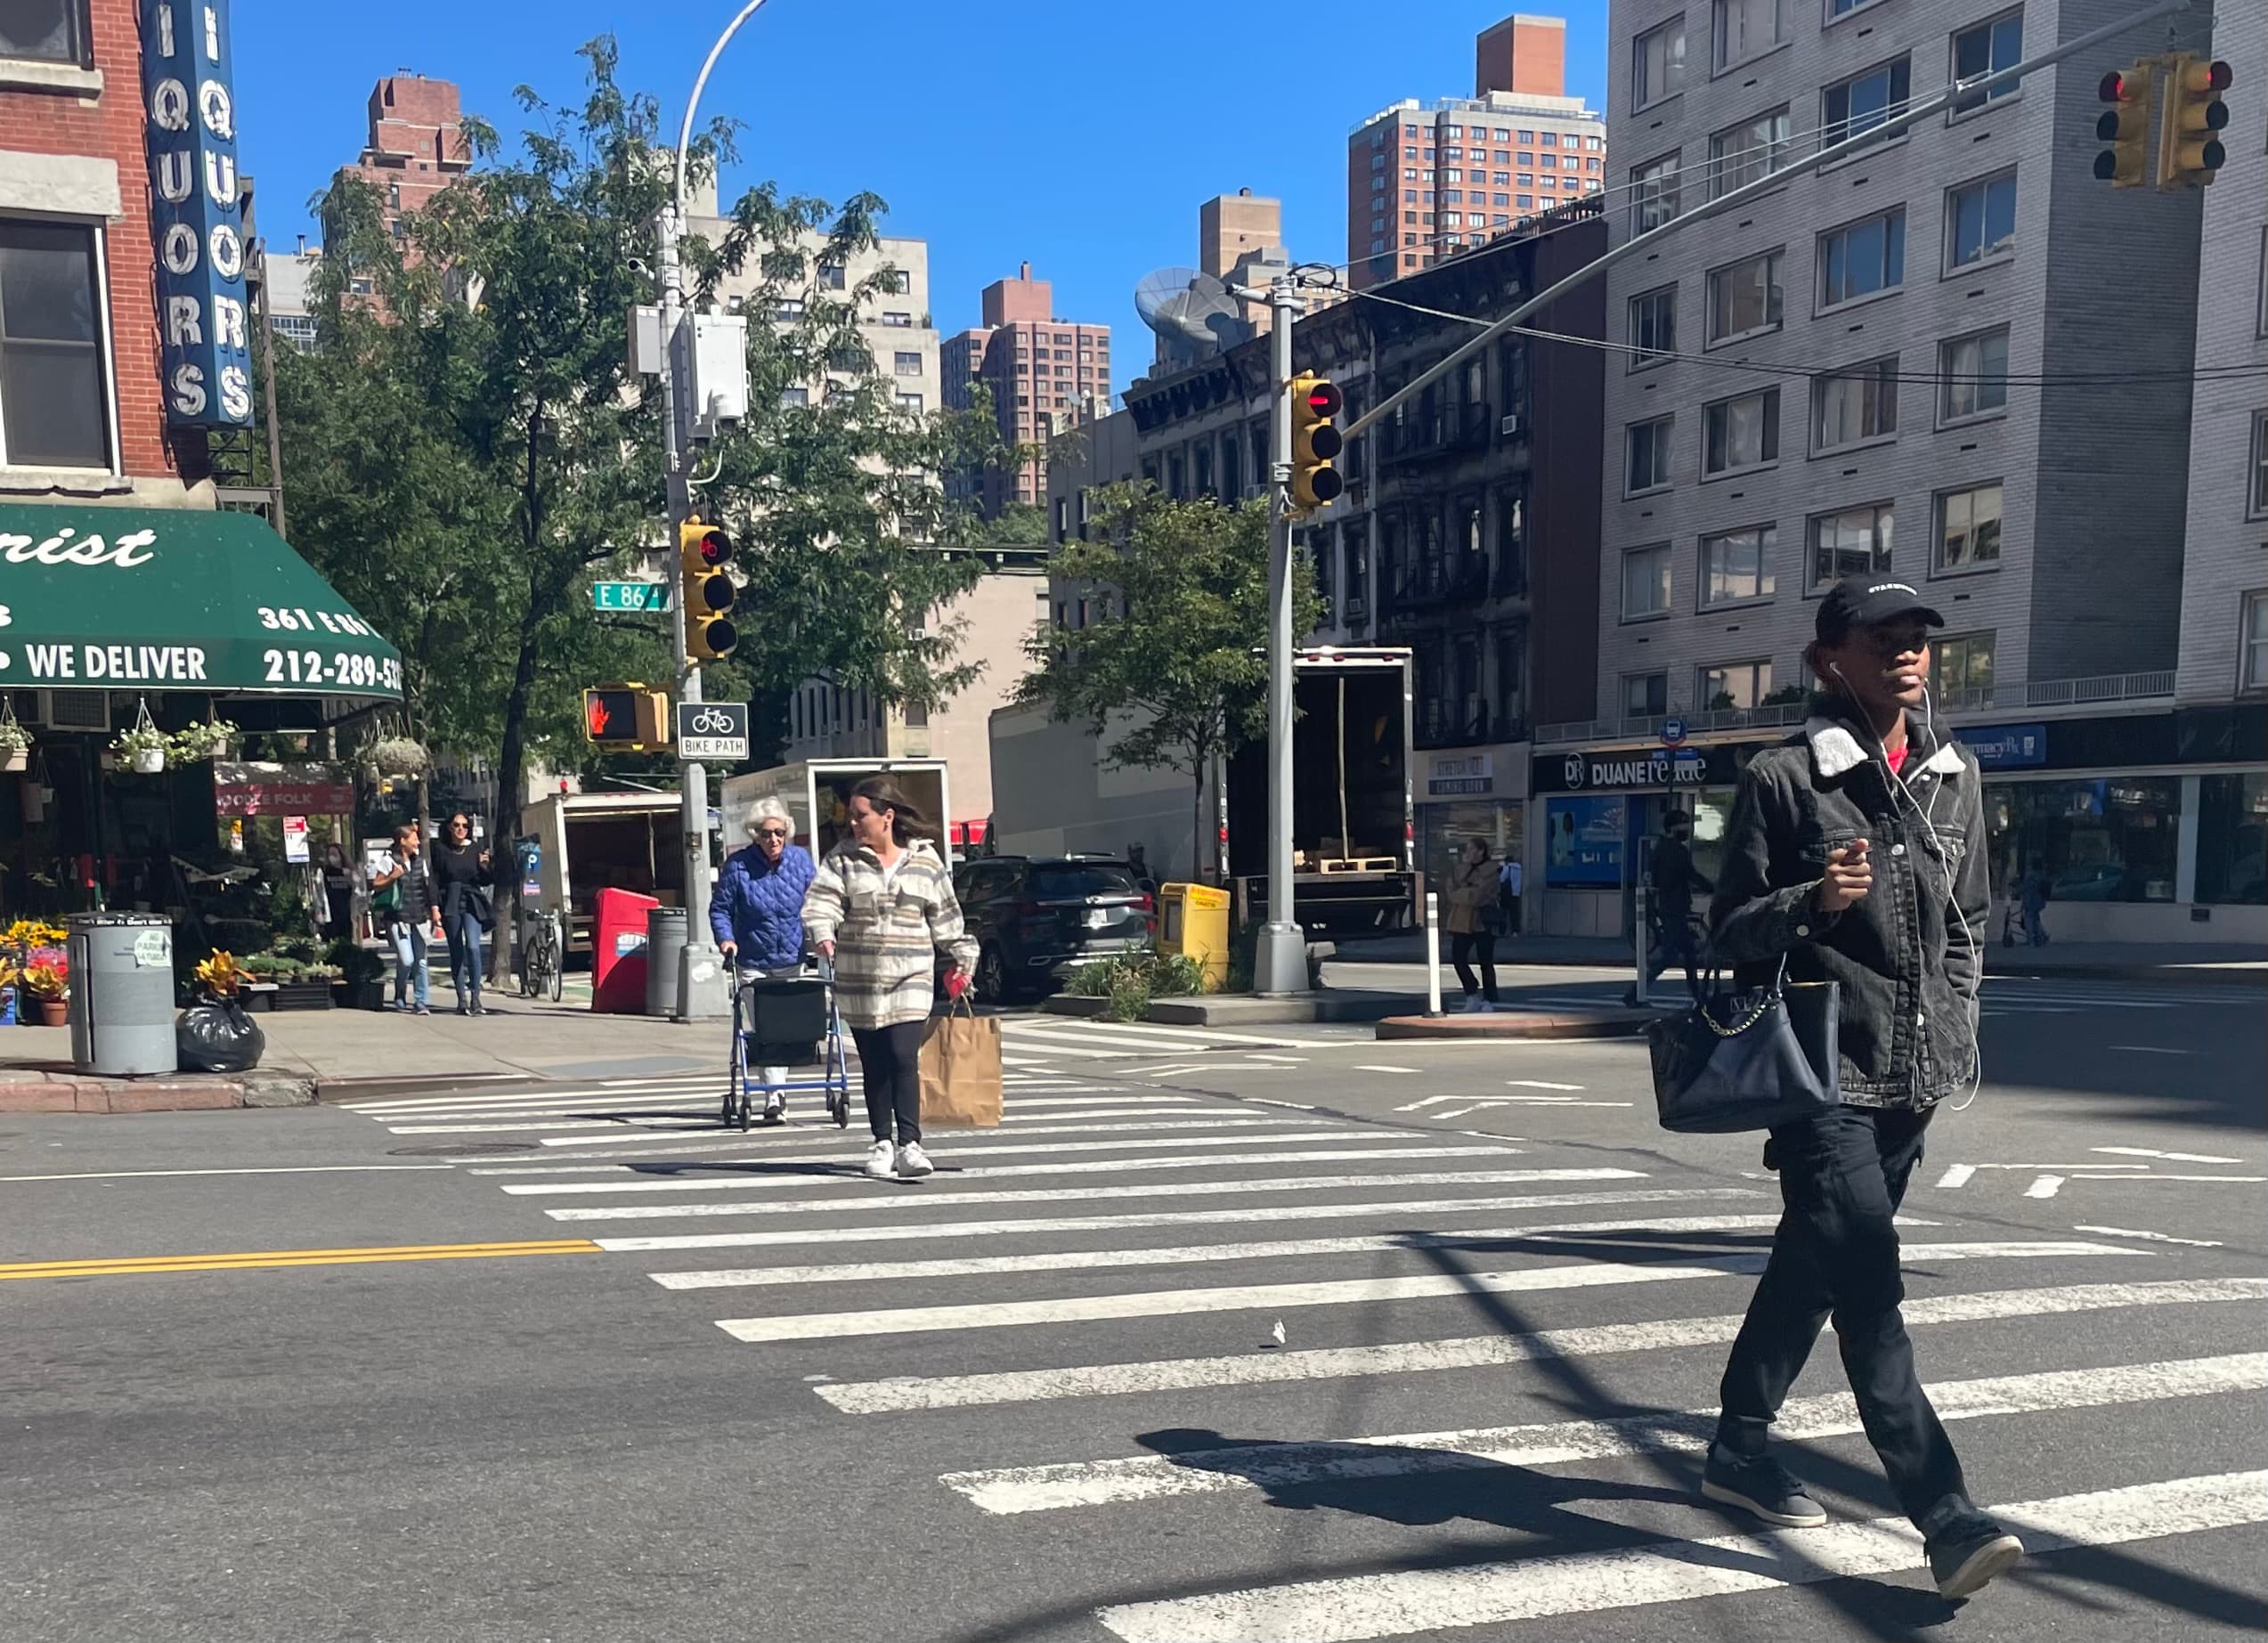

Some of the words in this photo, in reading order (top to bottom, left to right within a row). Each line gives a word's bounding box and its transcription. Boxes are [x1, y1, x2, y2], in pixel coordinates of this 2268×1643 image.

[601, 586, 612, 606] E
[621, 585, 645, 607] 86
[257, 607, 314, 630] 361
[25, 645, 76, 678] WE
[85, 646, 207, 679] DELIVER
[685, 740, 710, 752] BIKE
[716, 740, 743, 753] PATH
[1592, 761, 1646, 785] DUANE
[274, 793, 312, 805] FOLK
